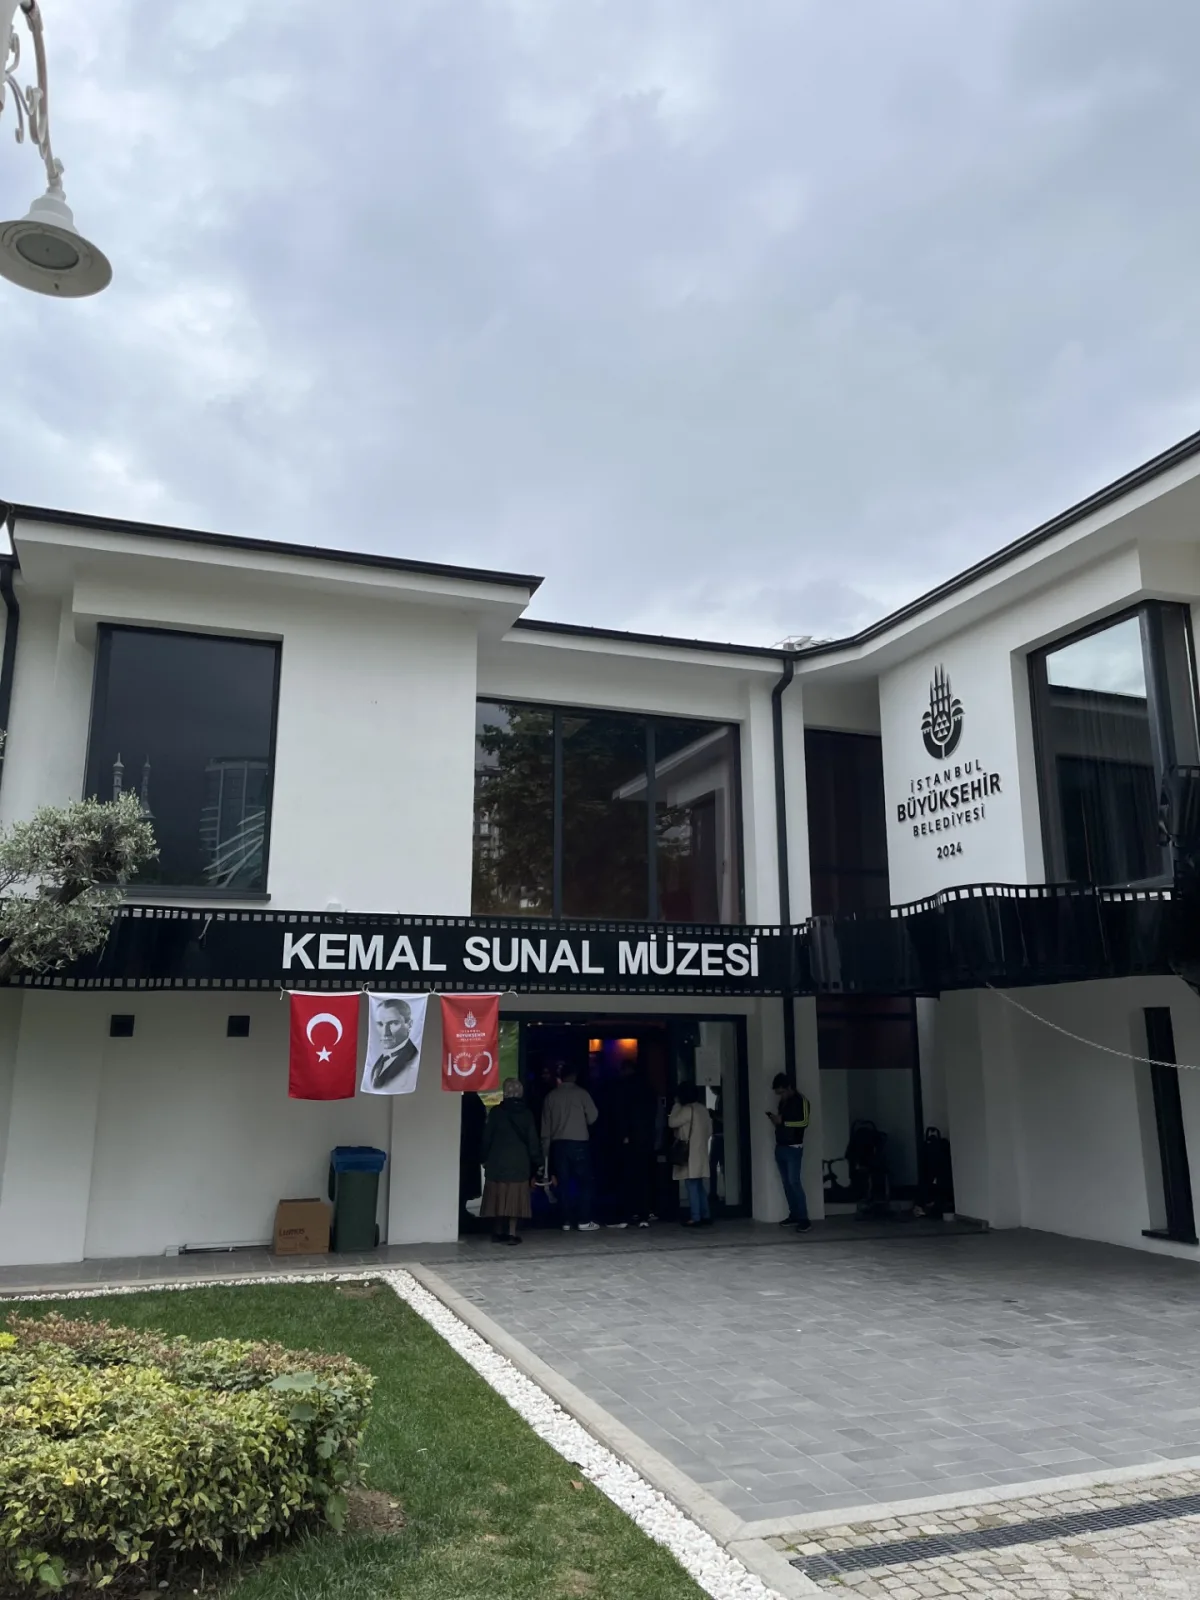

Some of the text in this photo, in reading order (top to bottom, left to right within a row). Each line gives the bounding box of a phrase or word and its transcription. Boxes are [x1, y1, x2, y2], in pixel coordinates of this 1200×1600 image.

[910, 759, 982, 793] İSTANBUL
[897, 772, 1001, 823] BÜYÜKŞEHİR
[913, 803, 985, 838] BELEDİYESİ
[936, 842, 963, 860] 2024
[282, 932, 759, 977] KEMAL SUNAL MÜZESİ
